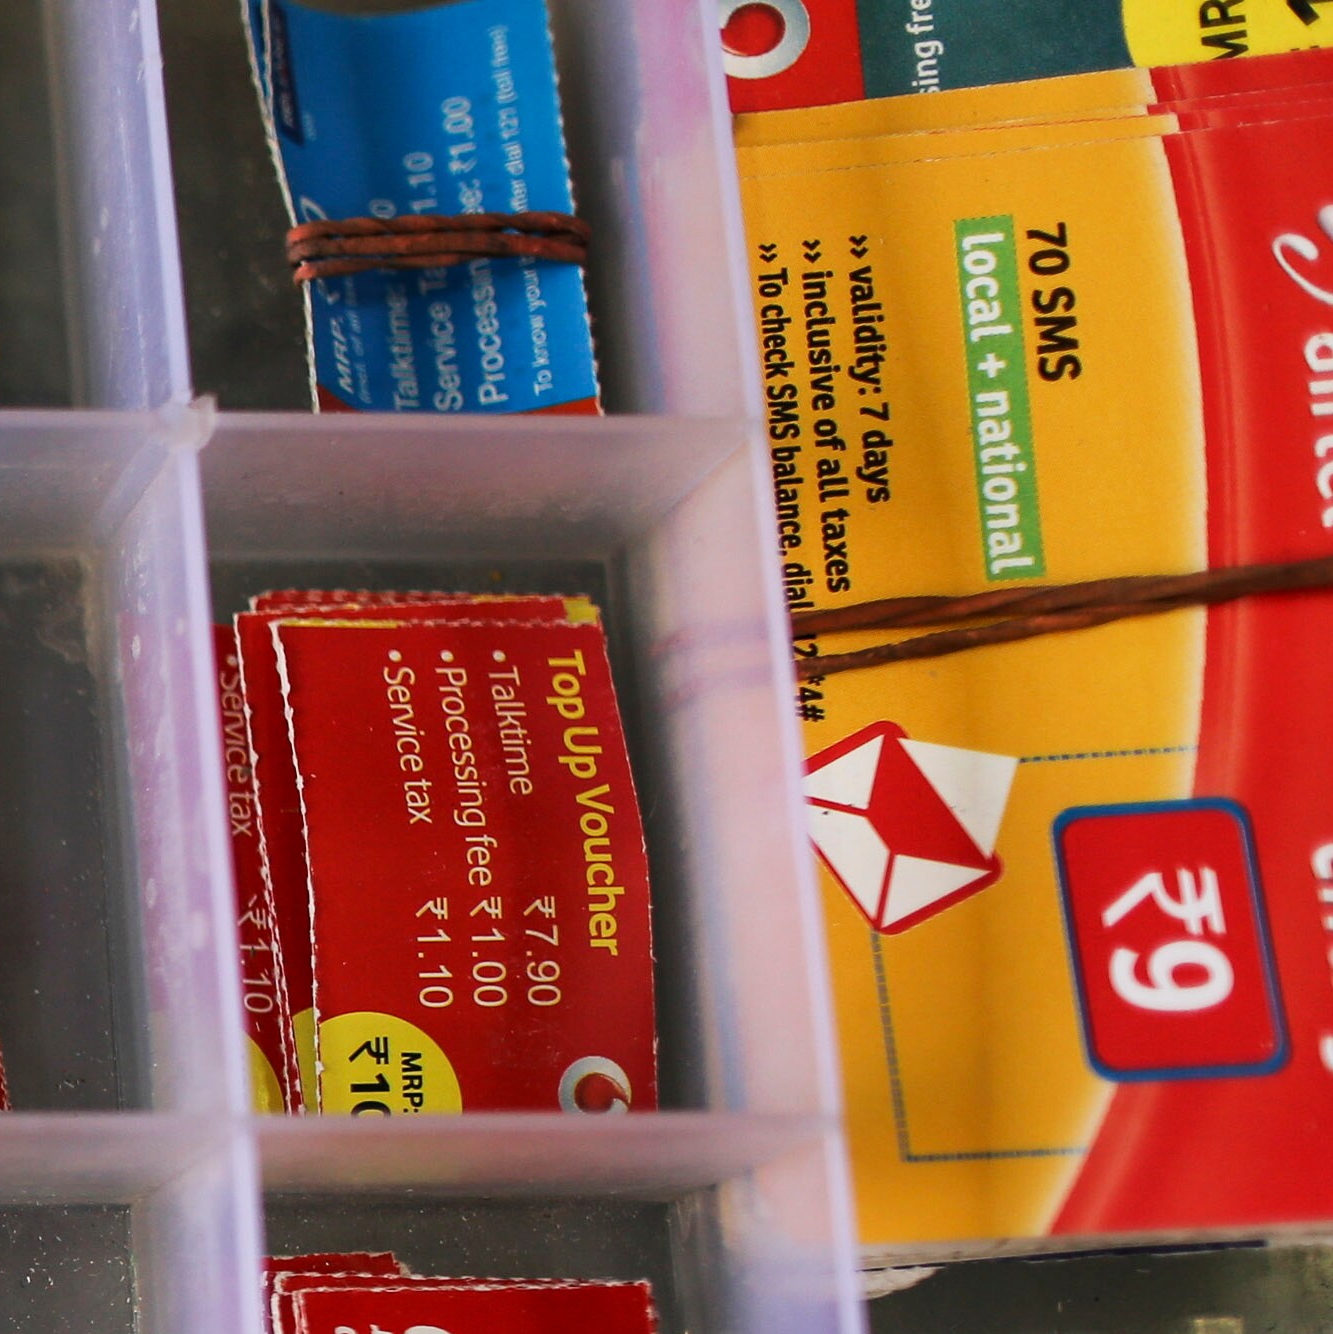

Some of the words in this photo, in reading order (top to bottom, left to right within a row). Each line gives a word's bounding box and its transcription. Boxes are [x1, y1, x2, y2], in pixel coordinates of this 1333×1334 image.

[758, 270, 790, 299] To
[962, 233, 1010, 343] local
[1027, 221, 1069, 276] 70
[429, 304, 462, 411] Service
[762, 304, 799, 387] check
[802, 271, 845, 411] inclusive
[847, 266, 890, 395] validity:
[1032, 286, 1083, 382] SMS
[765, 384, 797, 440] SMS
[815, 418, 846, 453] of
[859, 402, 890, 422] 7
[768, 447, 812, 557] balance,
[818, 458, 848, 502] all
[860, 430, 894, 504] days
[977, 391, 1034, 575] national
[782, 562, 815, 610] dial
[821, 508, 853, 593] taxes
[382, 666, 427, 773] Service
[546, 650, 585, 719] Top
[435, 667, 488, 827] Processing
[467, 834, 497, 886] fee
[557, 727, 602, 779] Up
[404, 779, 433, 825] tax
[574, 784, 624, 956] Voucher
[1101, 867, 1235, 1012] ₹9
[401, 1051, 423, 1114] MRP:
